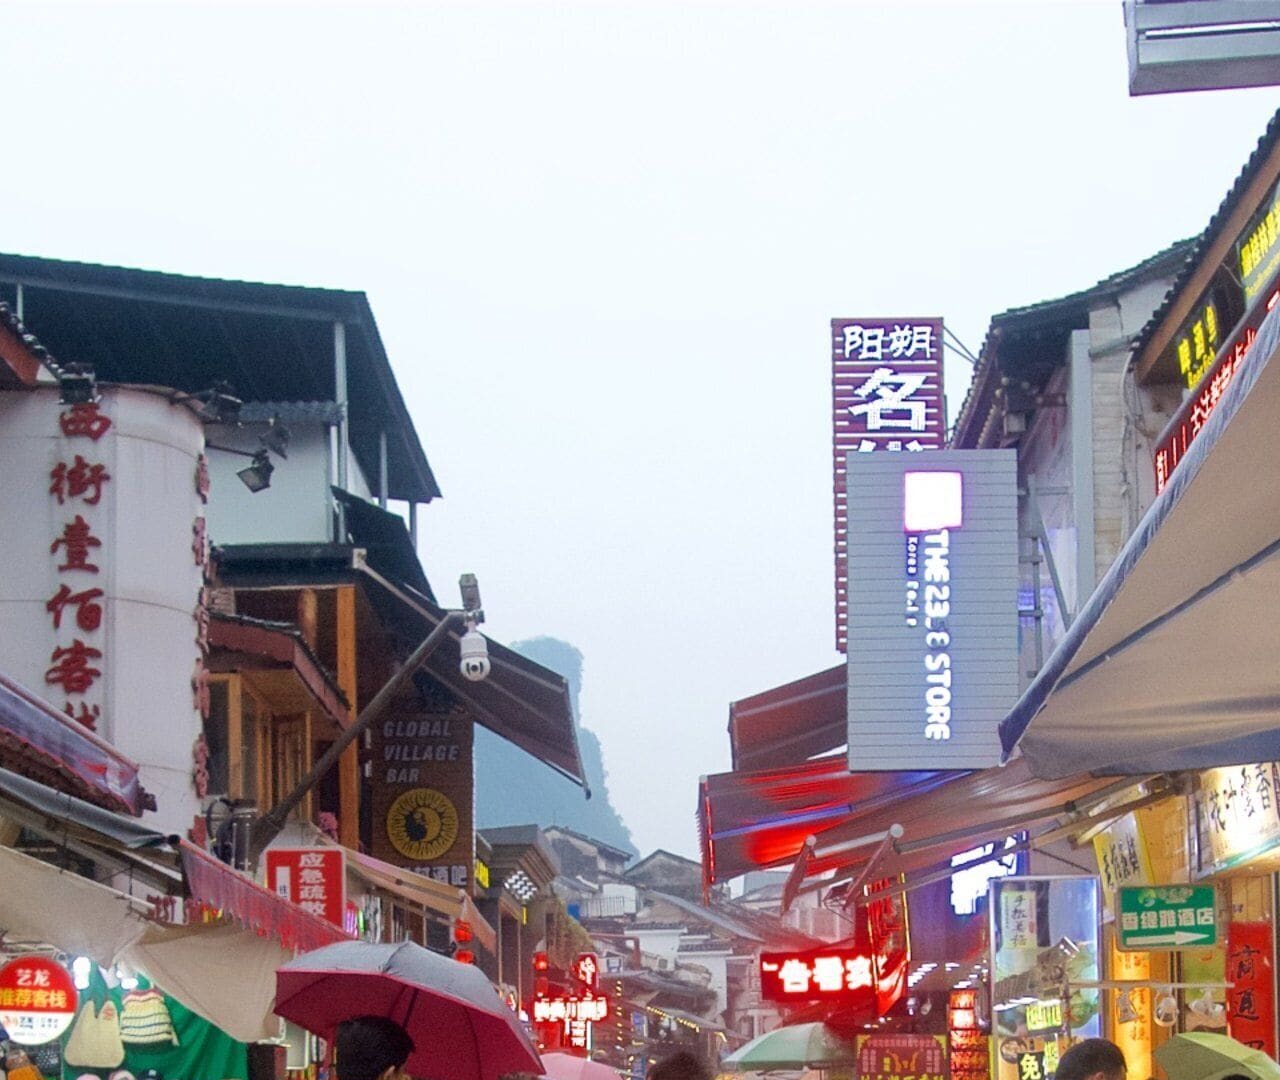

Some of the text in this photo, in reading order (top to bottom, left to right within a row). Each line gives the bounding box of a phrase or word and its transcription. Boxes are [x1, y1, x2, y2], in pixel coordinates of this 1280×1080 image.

[843, 325, 933, 360] 阳朔
[848, 367, 926, 451] 名
[924, 652, 951, 740] STORE
[383, 720, 452, 738] GLOBAL
[384, 744, 460, 762] VILLAGE
[387, 768, 420, 783] BAR
[299, 853, 327, 917] 应急疏散
[17, 969, 50, 987] 艺龙
